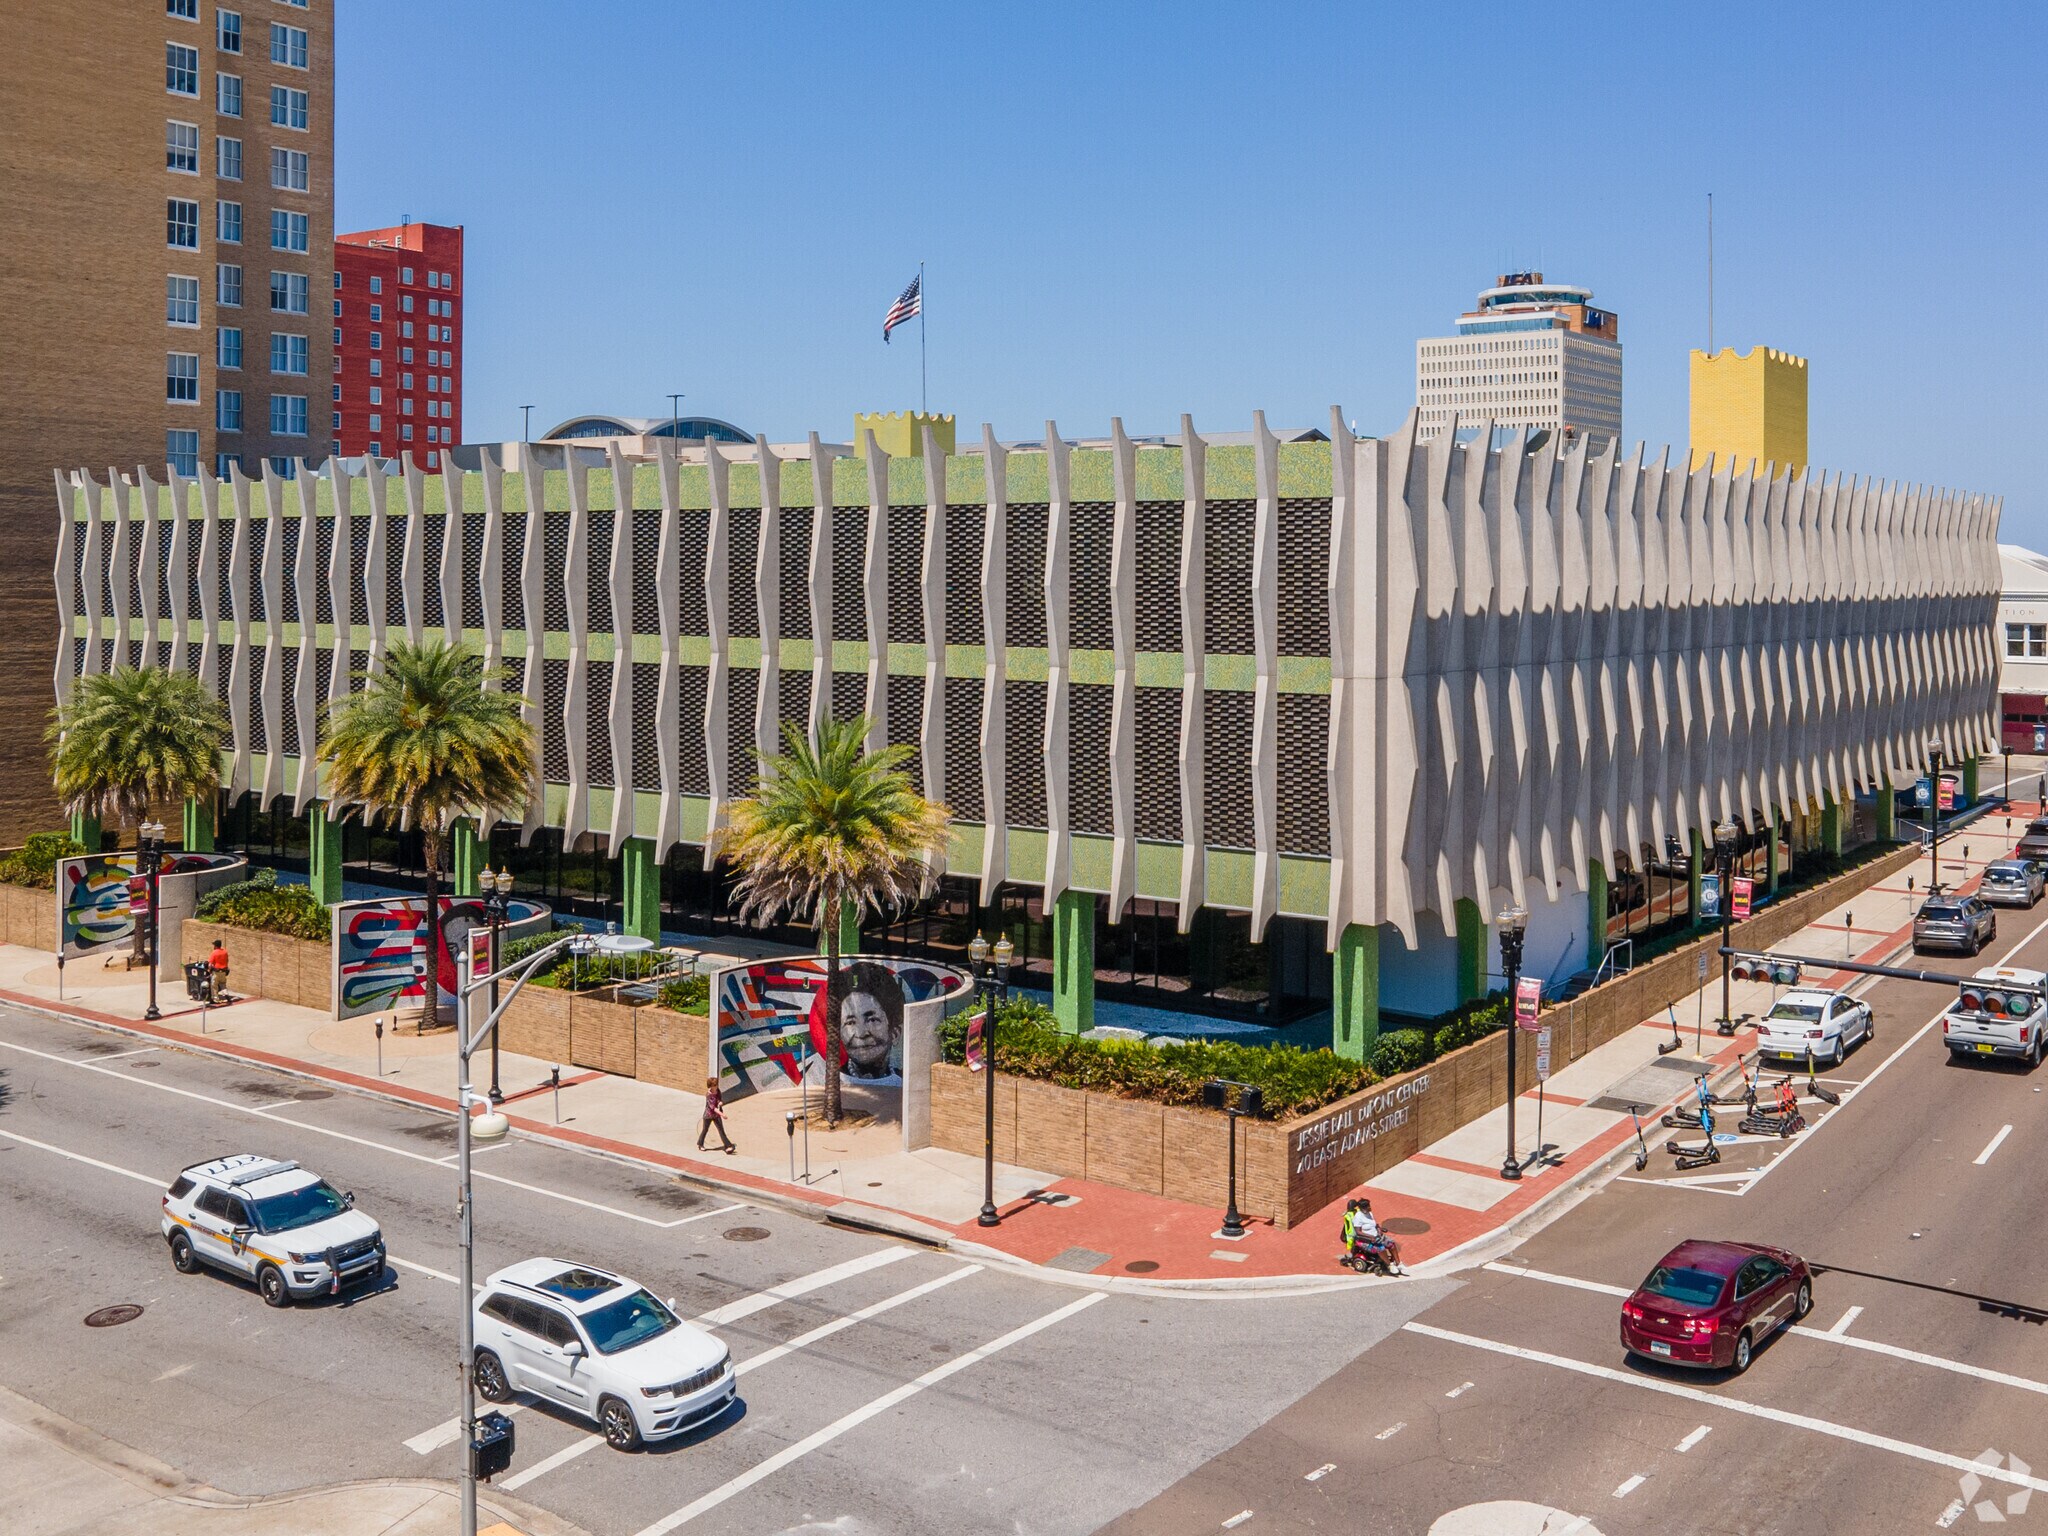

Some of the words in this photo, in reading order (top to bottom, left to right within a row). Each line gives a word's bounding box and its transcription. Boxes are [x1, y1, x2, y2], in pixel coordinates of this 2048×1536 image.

[1296, 1154, 1311, 1173] 40
[1314, 1141, 1338, 1168] EAST
[1341, 1122, 1378, 1155] ADAMS
[1379, 1106, 1409, 1135] STREET
[1297, 1120, 1329, 1151] JESSIE
[1331, 1110, 1354, 1135] BALL
[1397, 1075, 1430, 1103] CENTER
